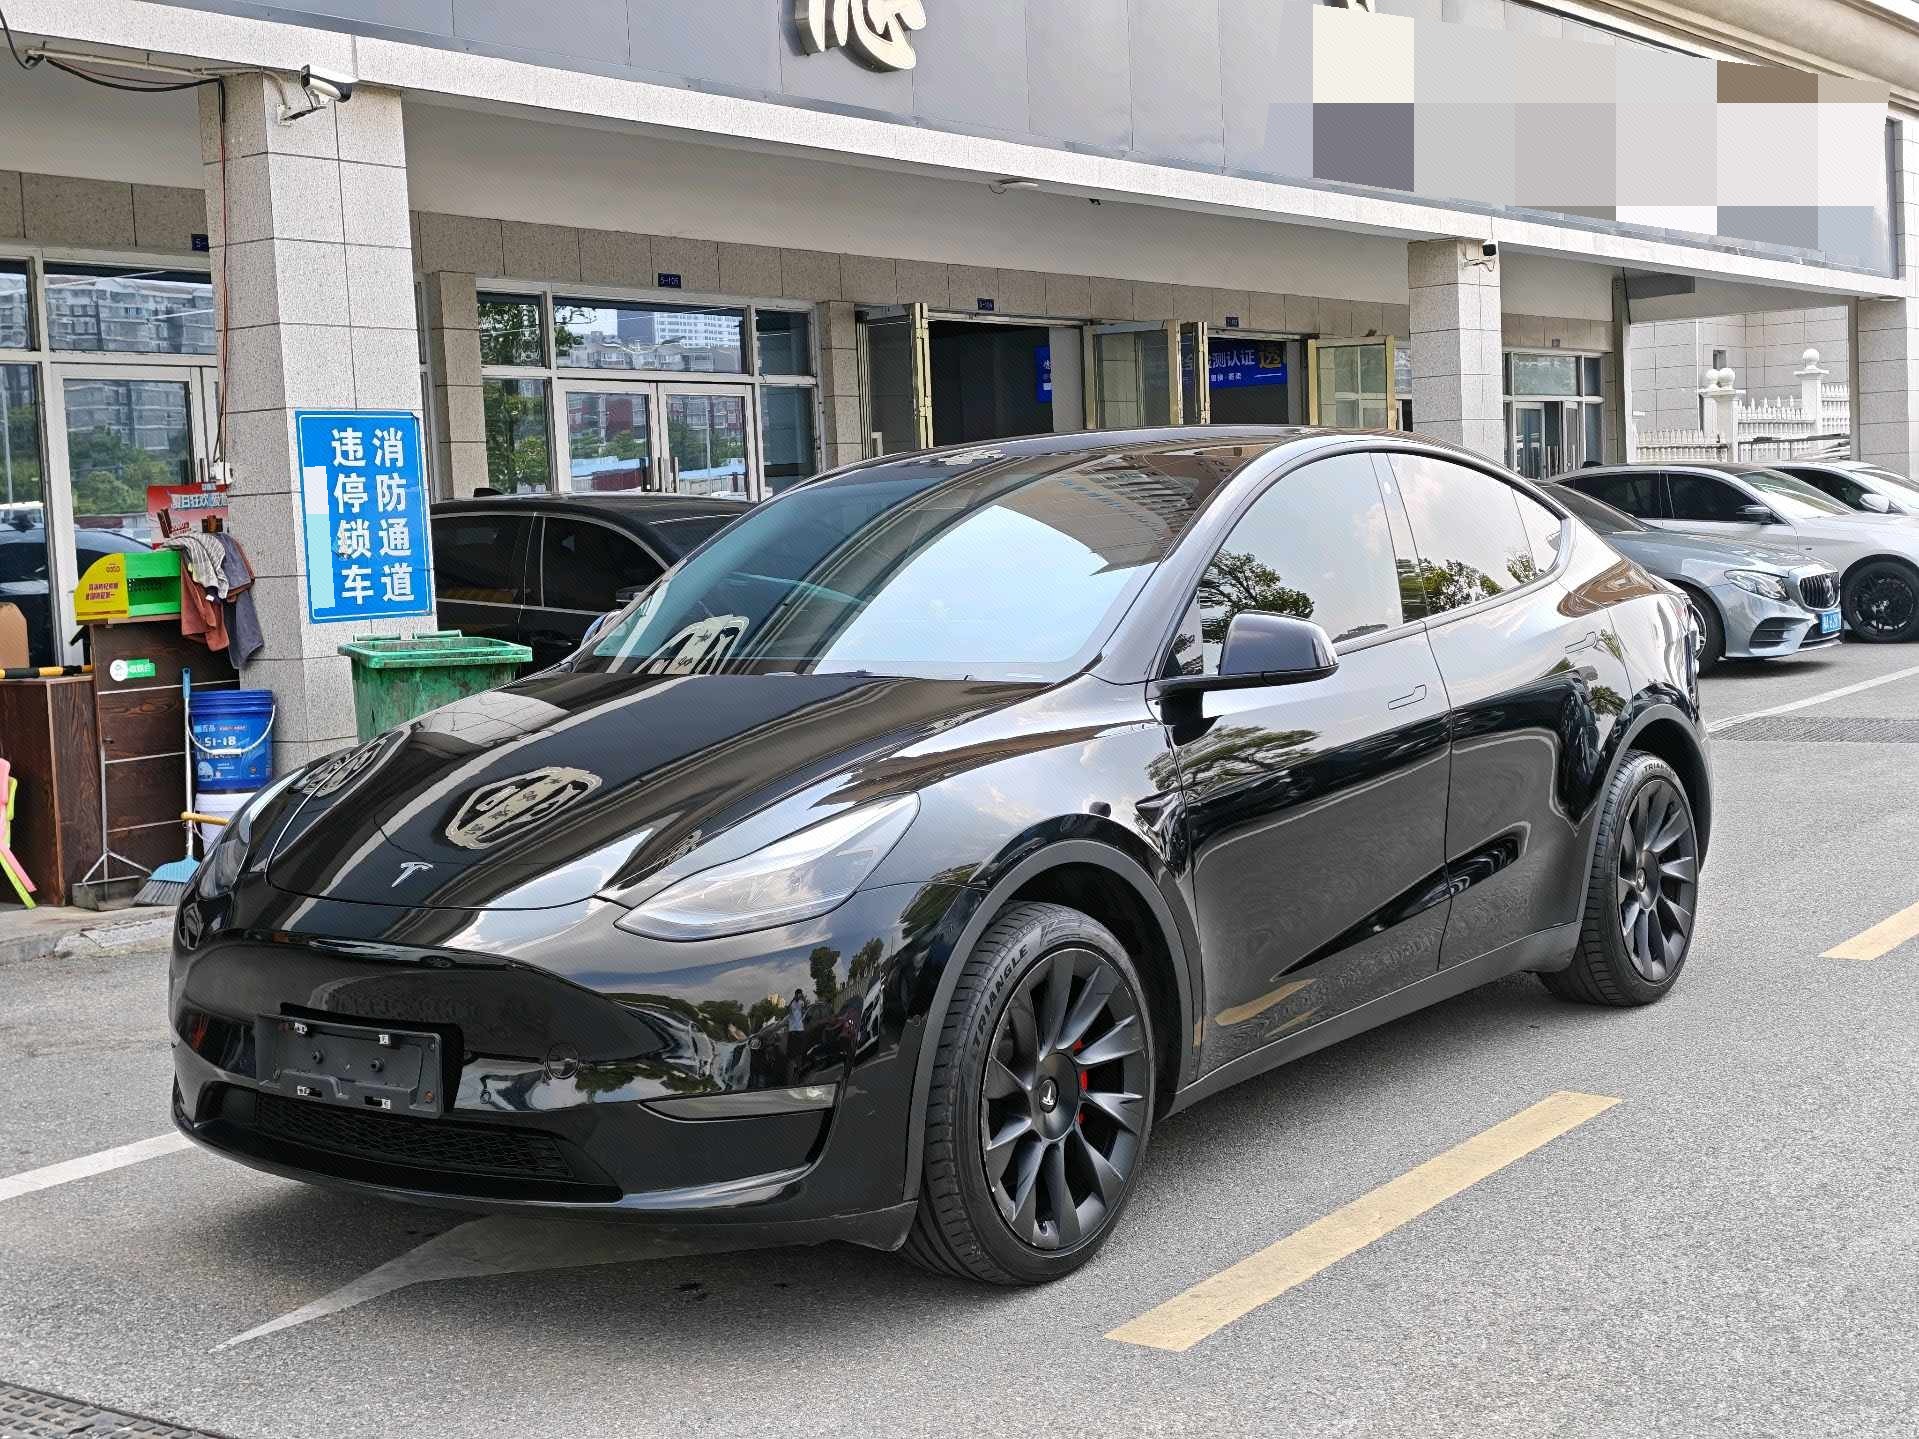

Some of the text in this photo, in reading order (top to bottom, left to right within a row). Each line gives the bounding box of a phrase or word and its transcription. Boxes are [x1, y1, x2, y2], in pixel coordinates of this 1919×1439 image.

[331, 427, 375, 605] 违停锁车
[371, 427, 415, 602] 消防通道
[973, 944, 1029, 1049] TRIANGLE
